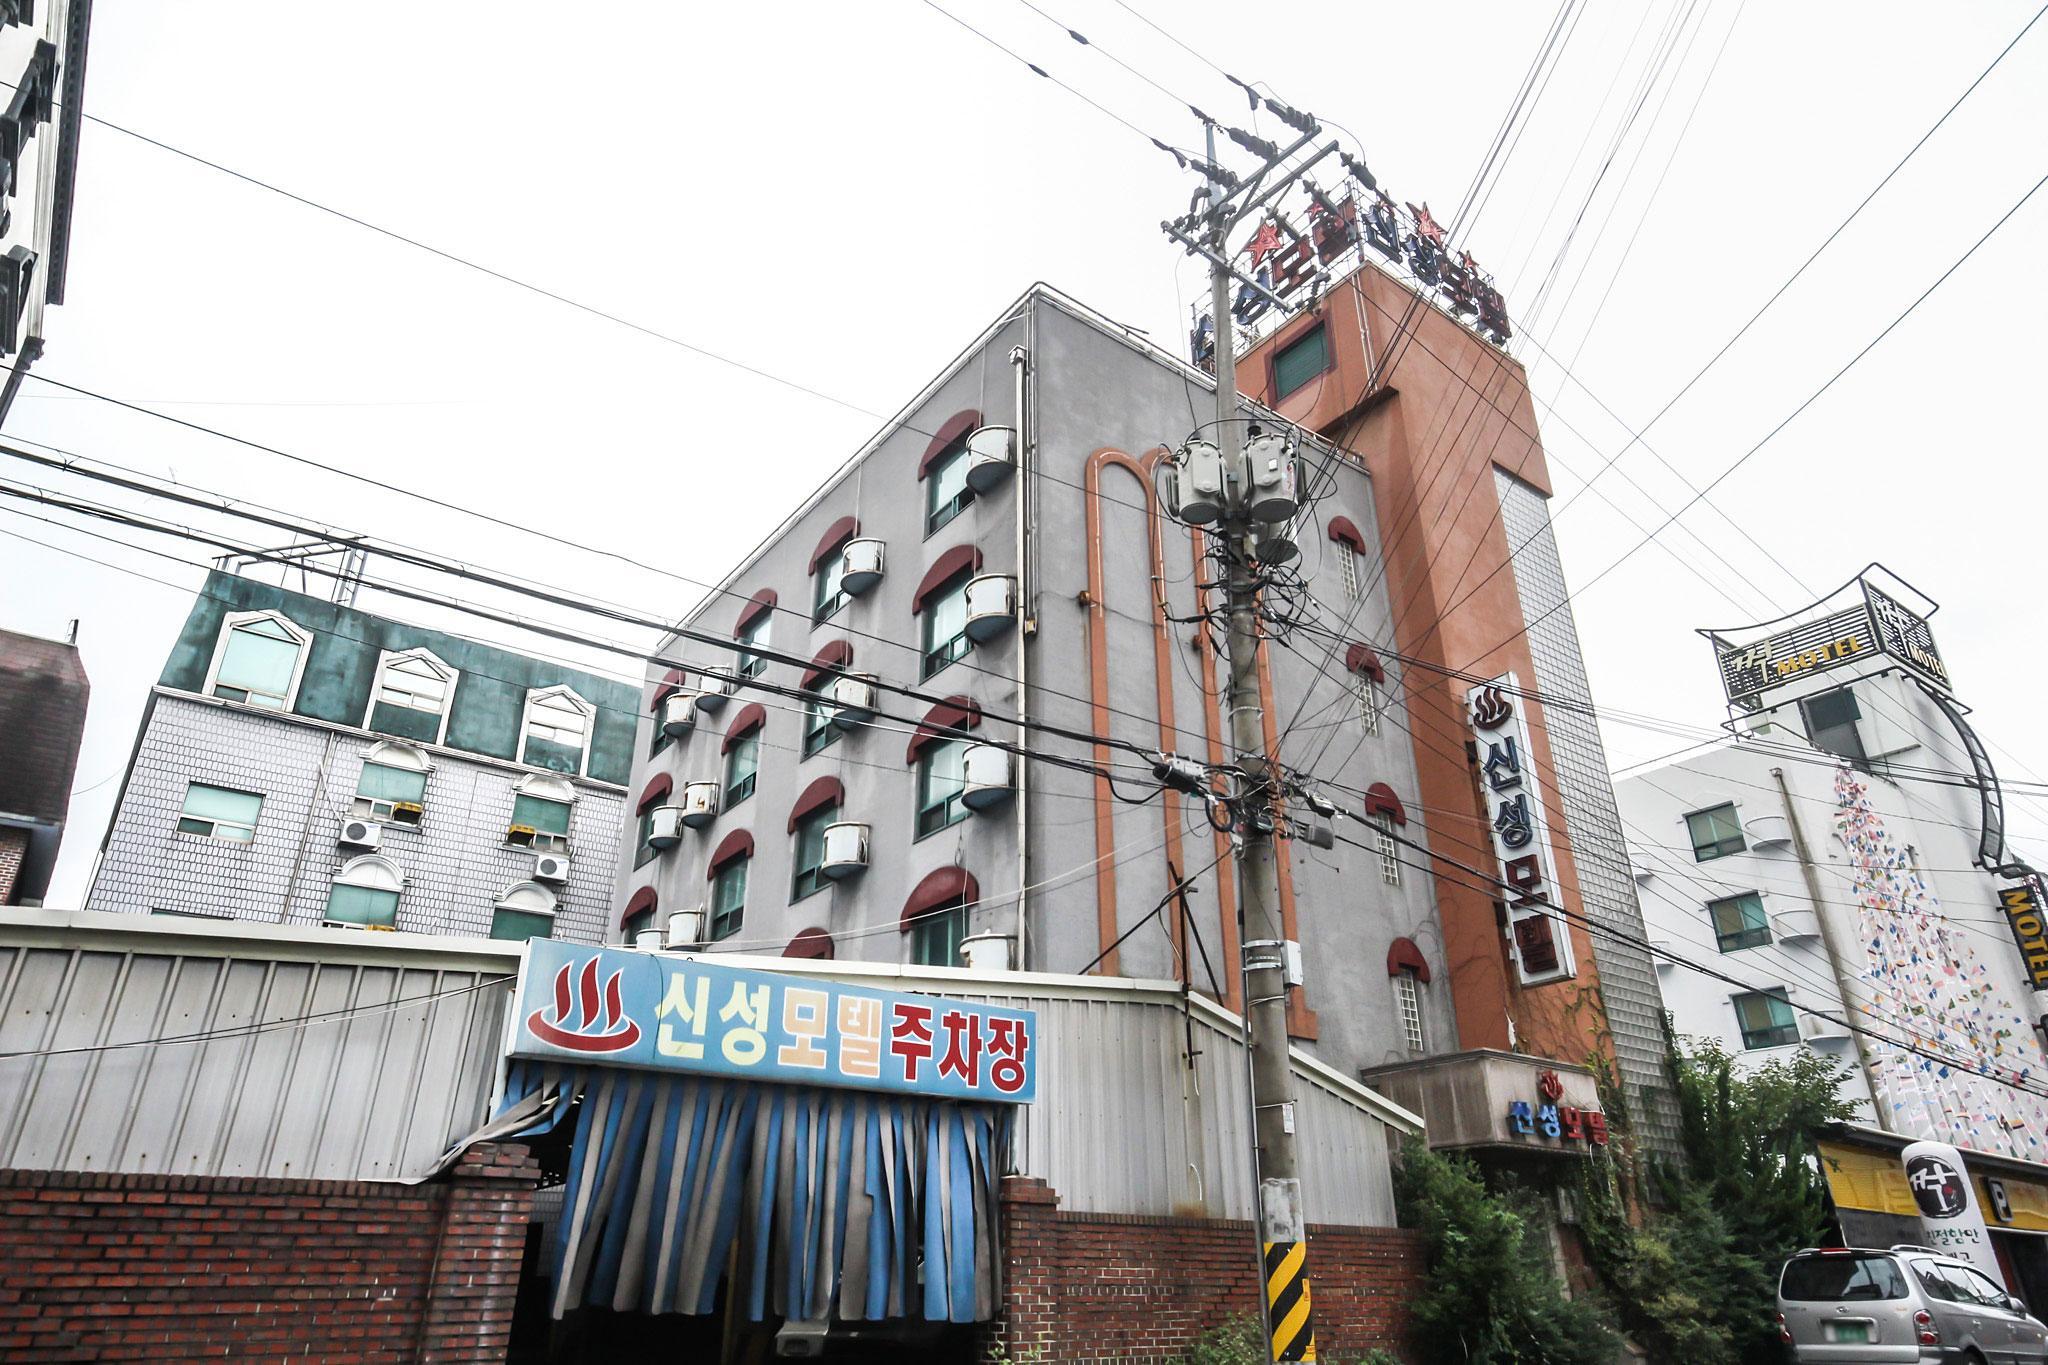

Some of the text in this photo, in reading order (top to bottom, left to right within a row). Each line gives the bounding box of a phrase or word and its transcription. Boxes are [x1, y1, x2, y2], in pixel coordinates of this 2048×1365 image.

[1777, 636, 1863, 677] MOTEL
[1909, 643, 1948, 678] MOTEL
[1483, 735, 1559, 975] 신성모텔
[2005, 891, 2048, 984] MOTEL
[1508, 1100, 1609, 1146] 신성모텔
